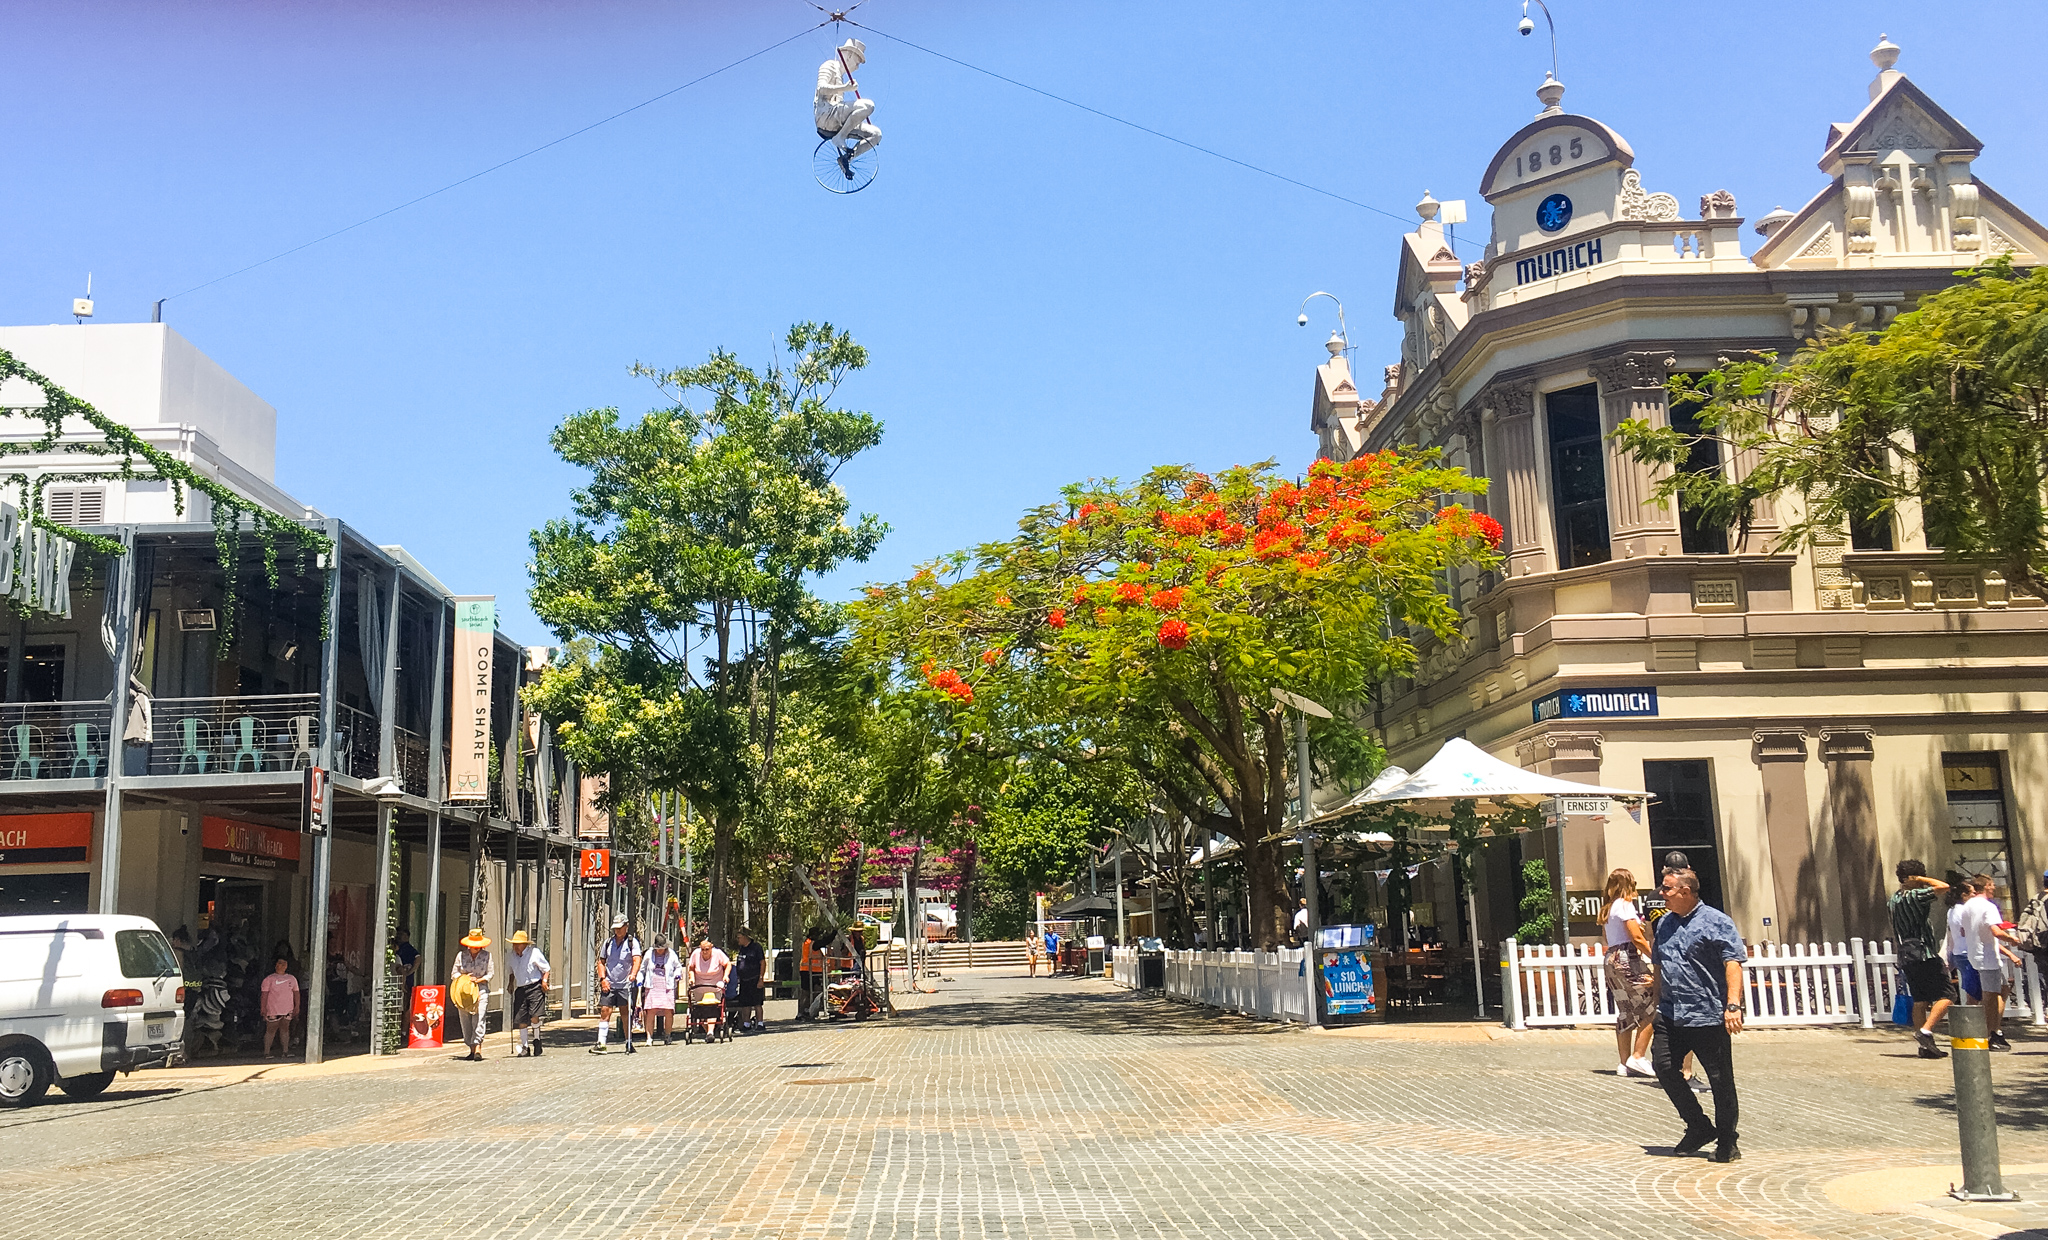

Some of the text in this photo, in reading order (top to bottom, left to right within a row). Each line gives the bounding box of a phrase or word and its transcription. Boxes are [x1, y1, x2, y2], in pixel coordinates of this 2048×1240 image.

[1516, 137, 1583, 178] 1885
[473, 647, 489, 760] COME SHARE
[1567, 801, 1598, 811] ERNEST
[230, 852, 244, 863] News
[1340, 971, 1356, 982] $10
[1334, 982, 1363, 993] LUNCH
